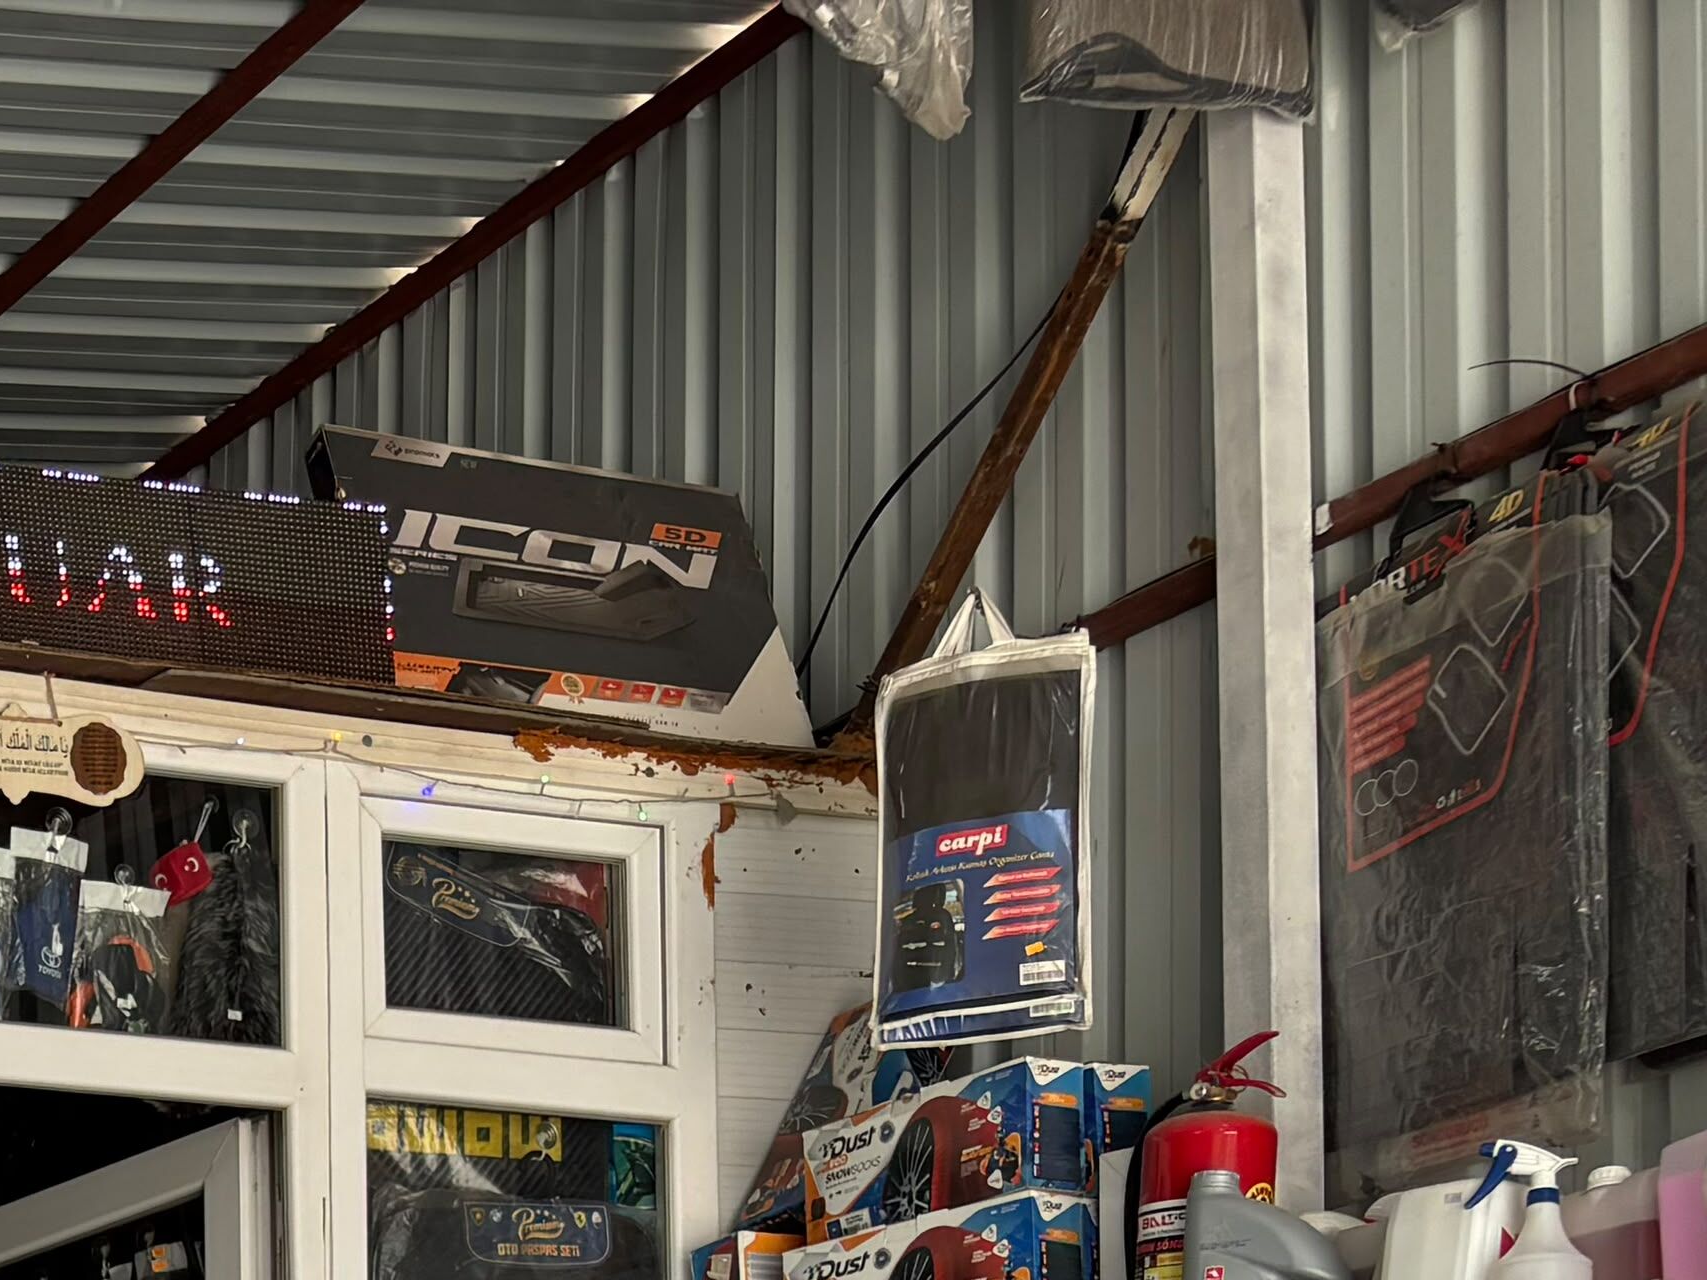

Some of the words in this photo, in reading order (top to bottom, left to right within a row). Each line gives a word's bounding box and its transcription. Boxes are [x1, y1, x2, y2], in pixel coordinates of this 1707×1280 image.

[1489, 489, 1525, 523] 4D
[393, 509, 722, 590] ICON
[664, 526, 708, 545] 5D
[938, 825, 1003, 856] carpi
[431, 876, 480, 920] Premium
[511, 1207, 566, 1242] Premium
[497, 1243, 518, 1256] OTO
[521, 1243, 558, 1257] PASPAS
